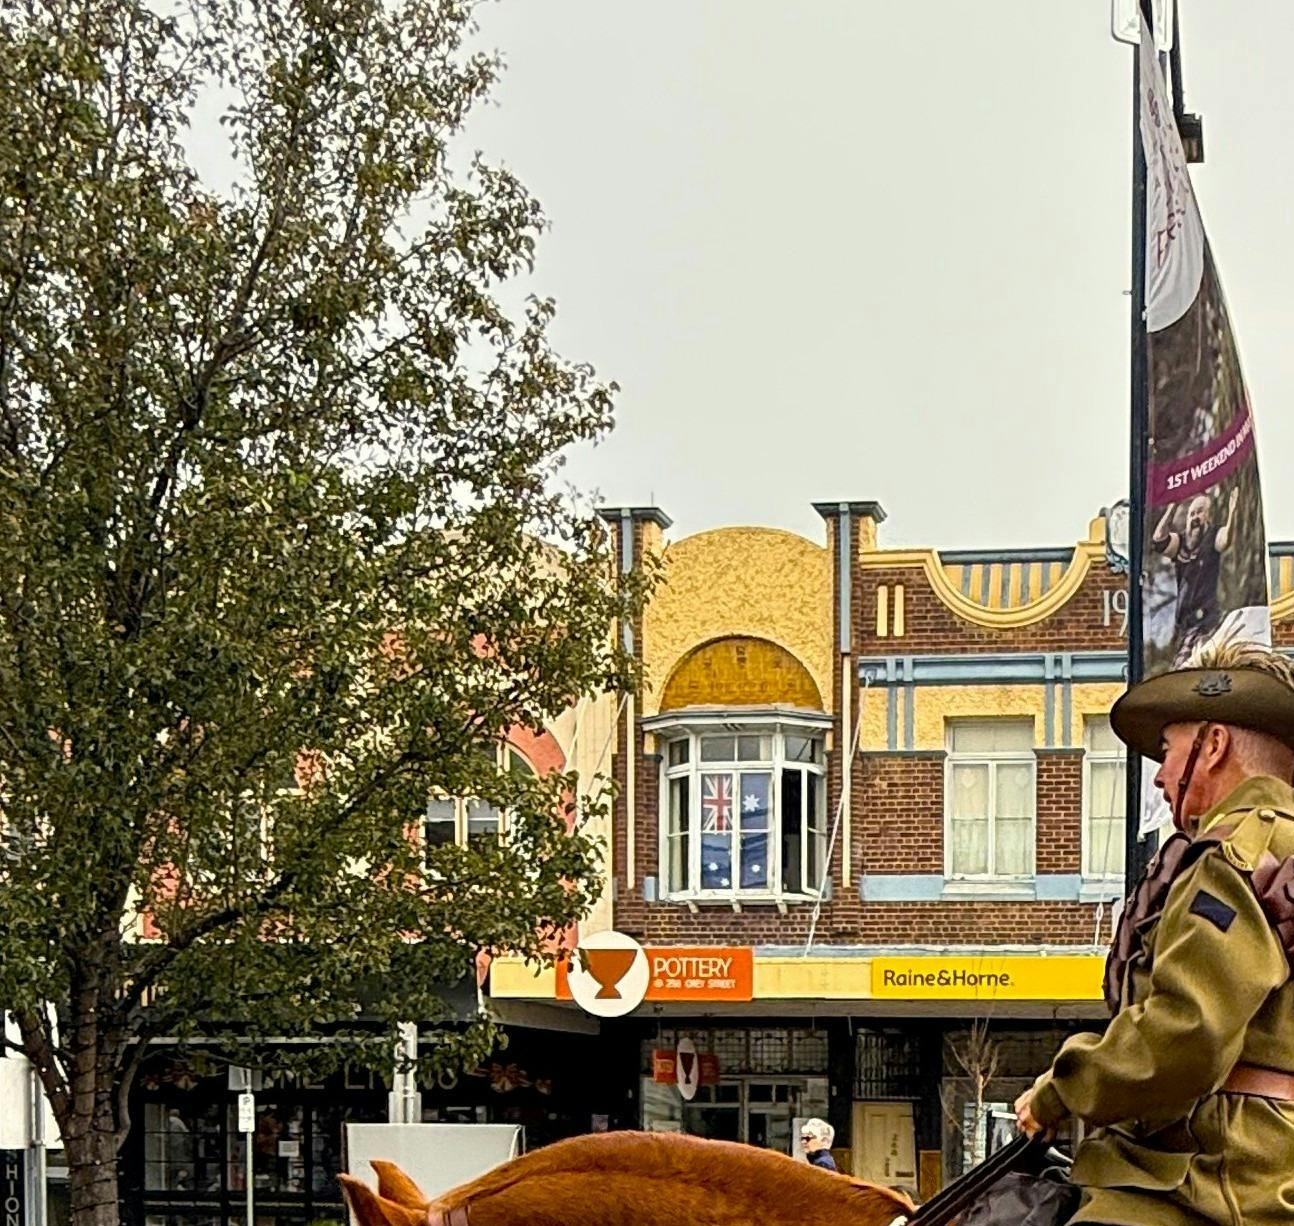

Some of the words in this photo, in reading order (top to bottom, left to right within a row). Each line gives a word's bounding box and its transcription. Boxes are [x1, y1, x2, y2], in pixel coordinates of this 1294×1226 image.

[1167, 469, 1189, 490] 1ST
[1190, 439, 1236, 481] WEEKEND
[653, 957, 733, 978] POTTERY
